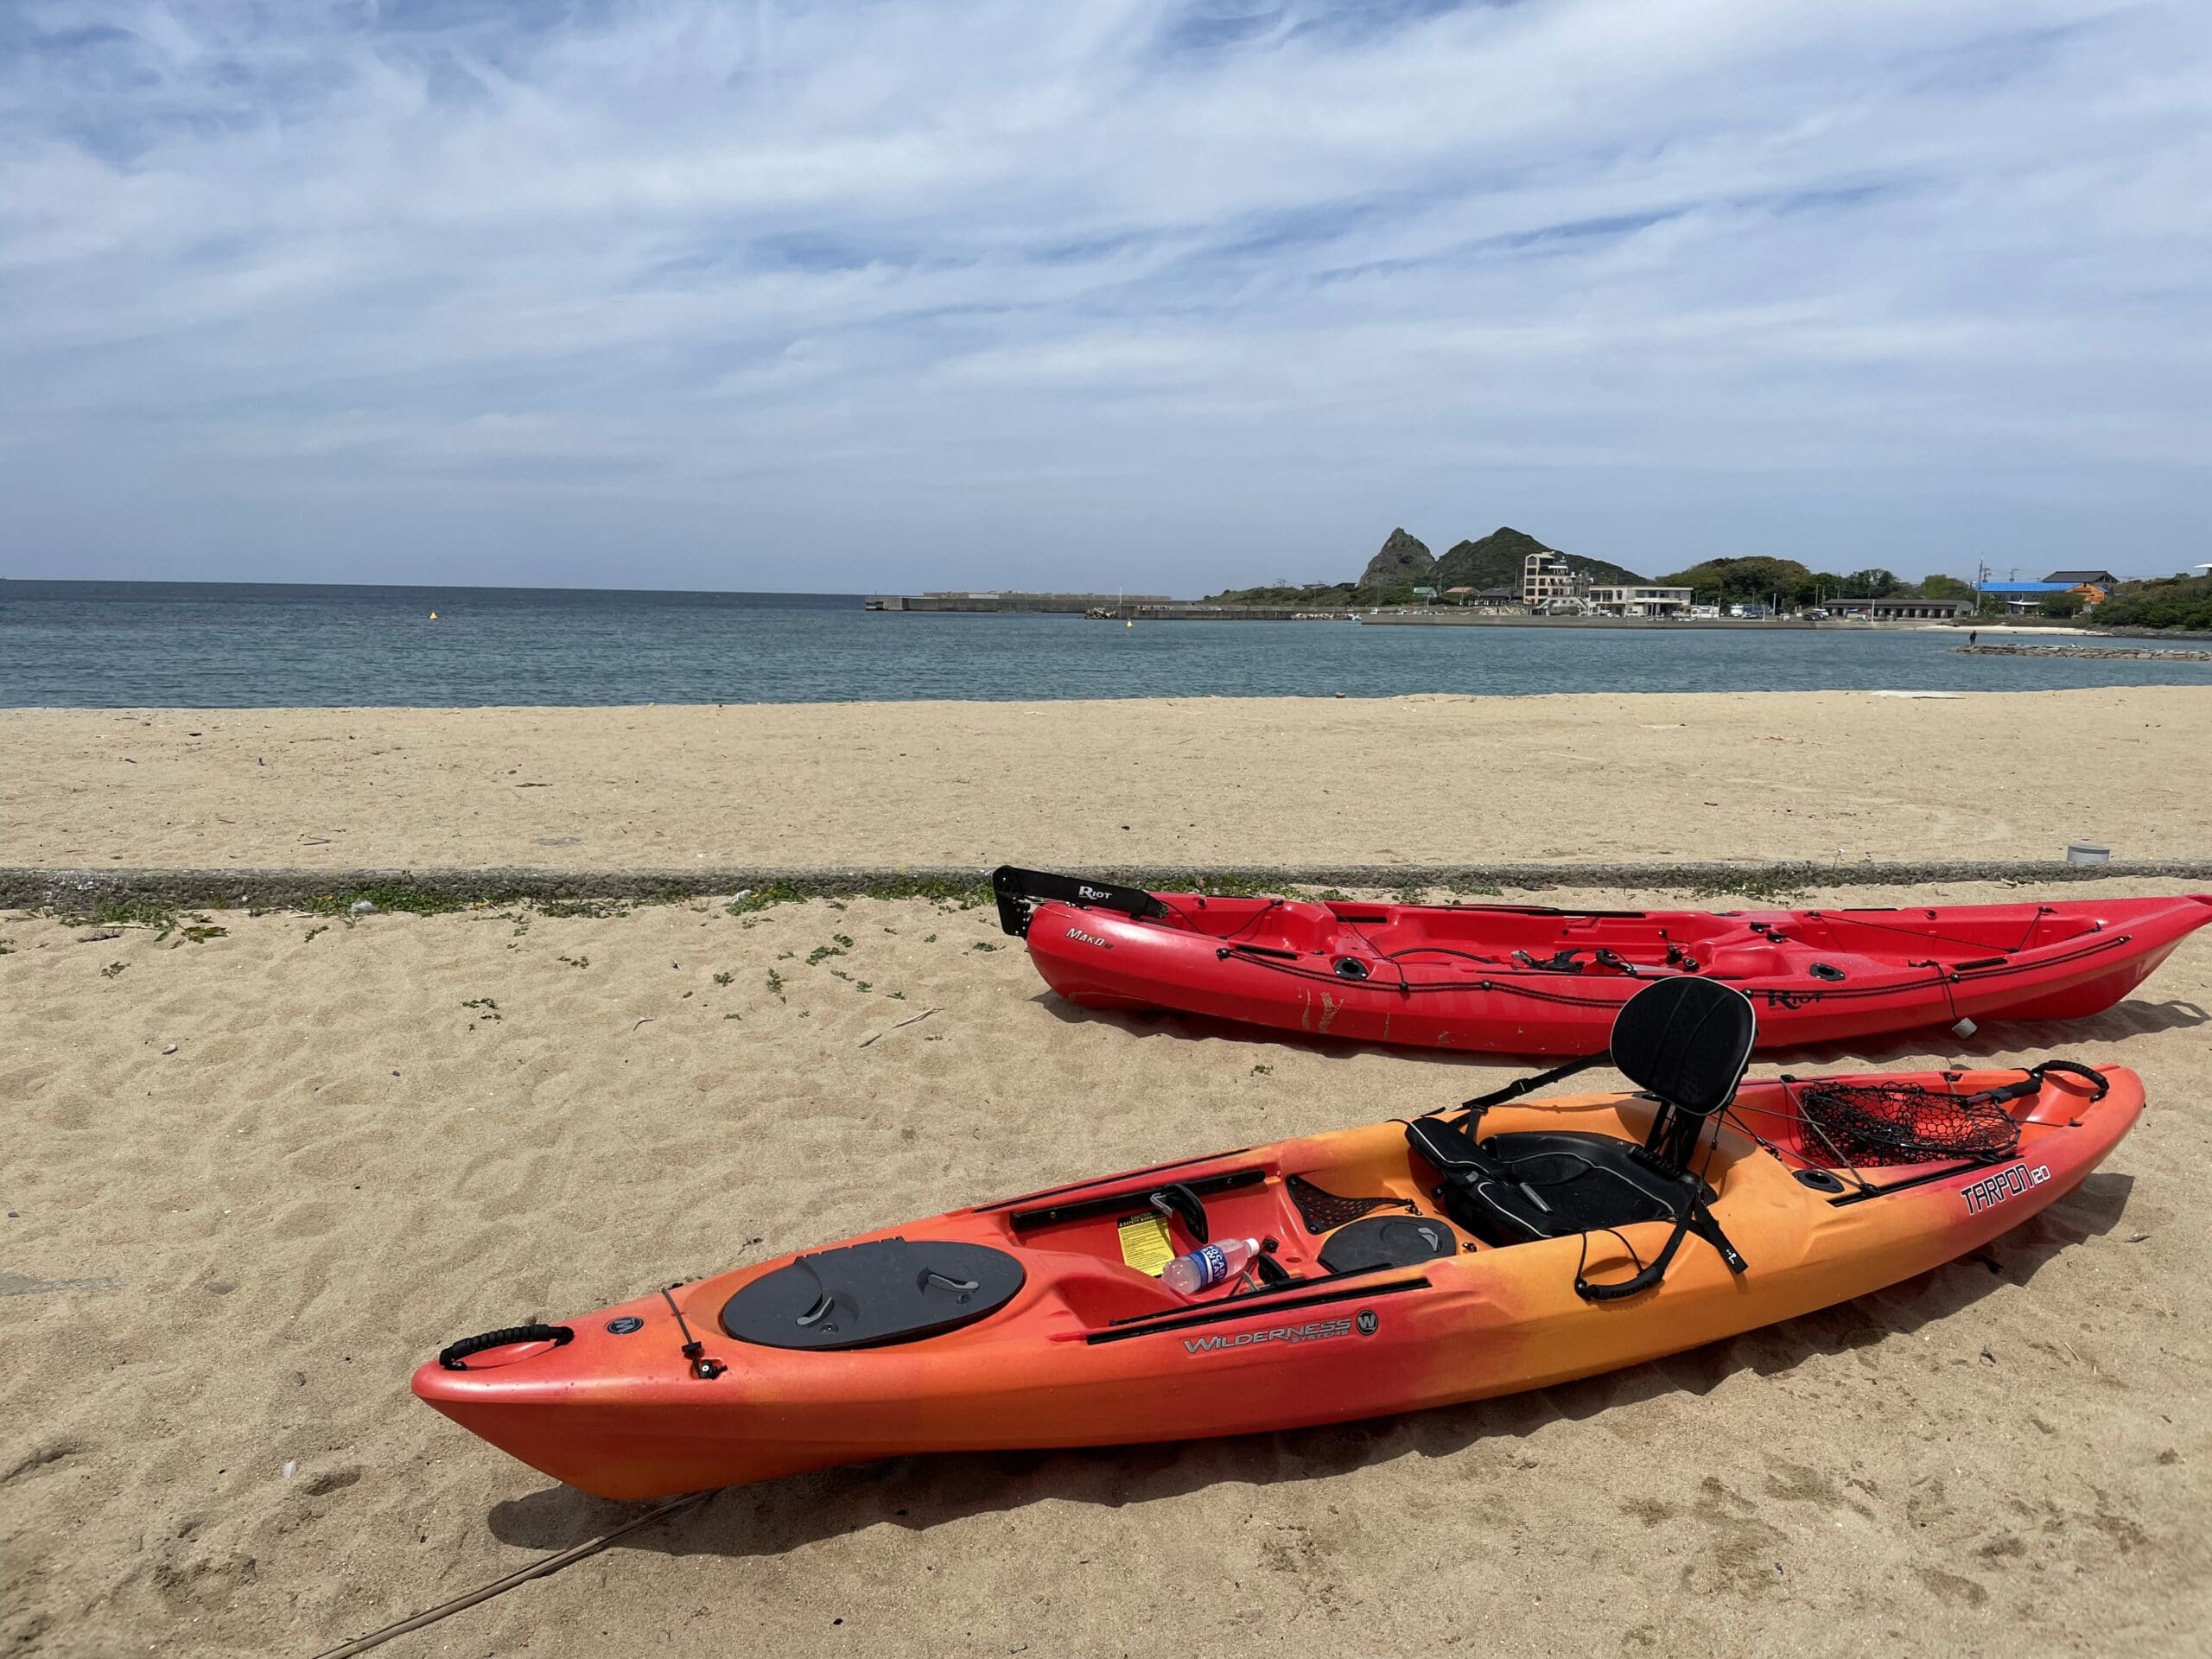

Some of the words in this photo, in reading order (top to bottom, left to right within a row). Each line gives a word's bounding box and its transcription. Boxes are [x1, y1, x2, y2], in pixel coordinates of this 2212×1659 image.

[1077, 886, 1113, 899] RIOT
[1065, 927, 1106, 946] MAKO
[1768, 989, 1824, 1010] RIOT
[1960, 1162, 2034, 1216] TARPON
[1184, 1319, 1351, 1353] WILDERNESS
[1291, 1329, 1349, 1343] SYSTEMS
